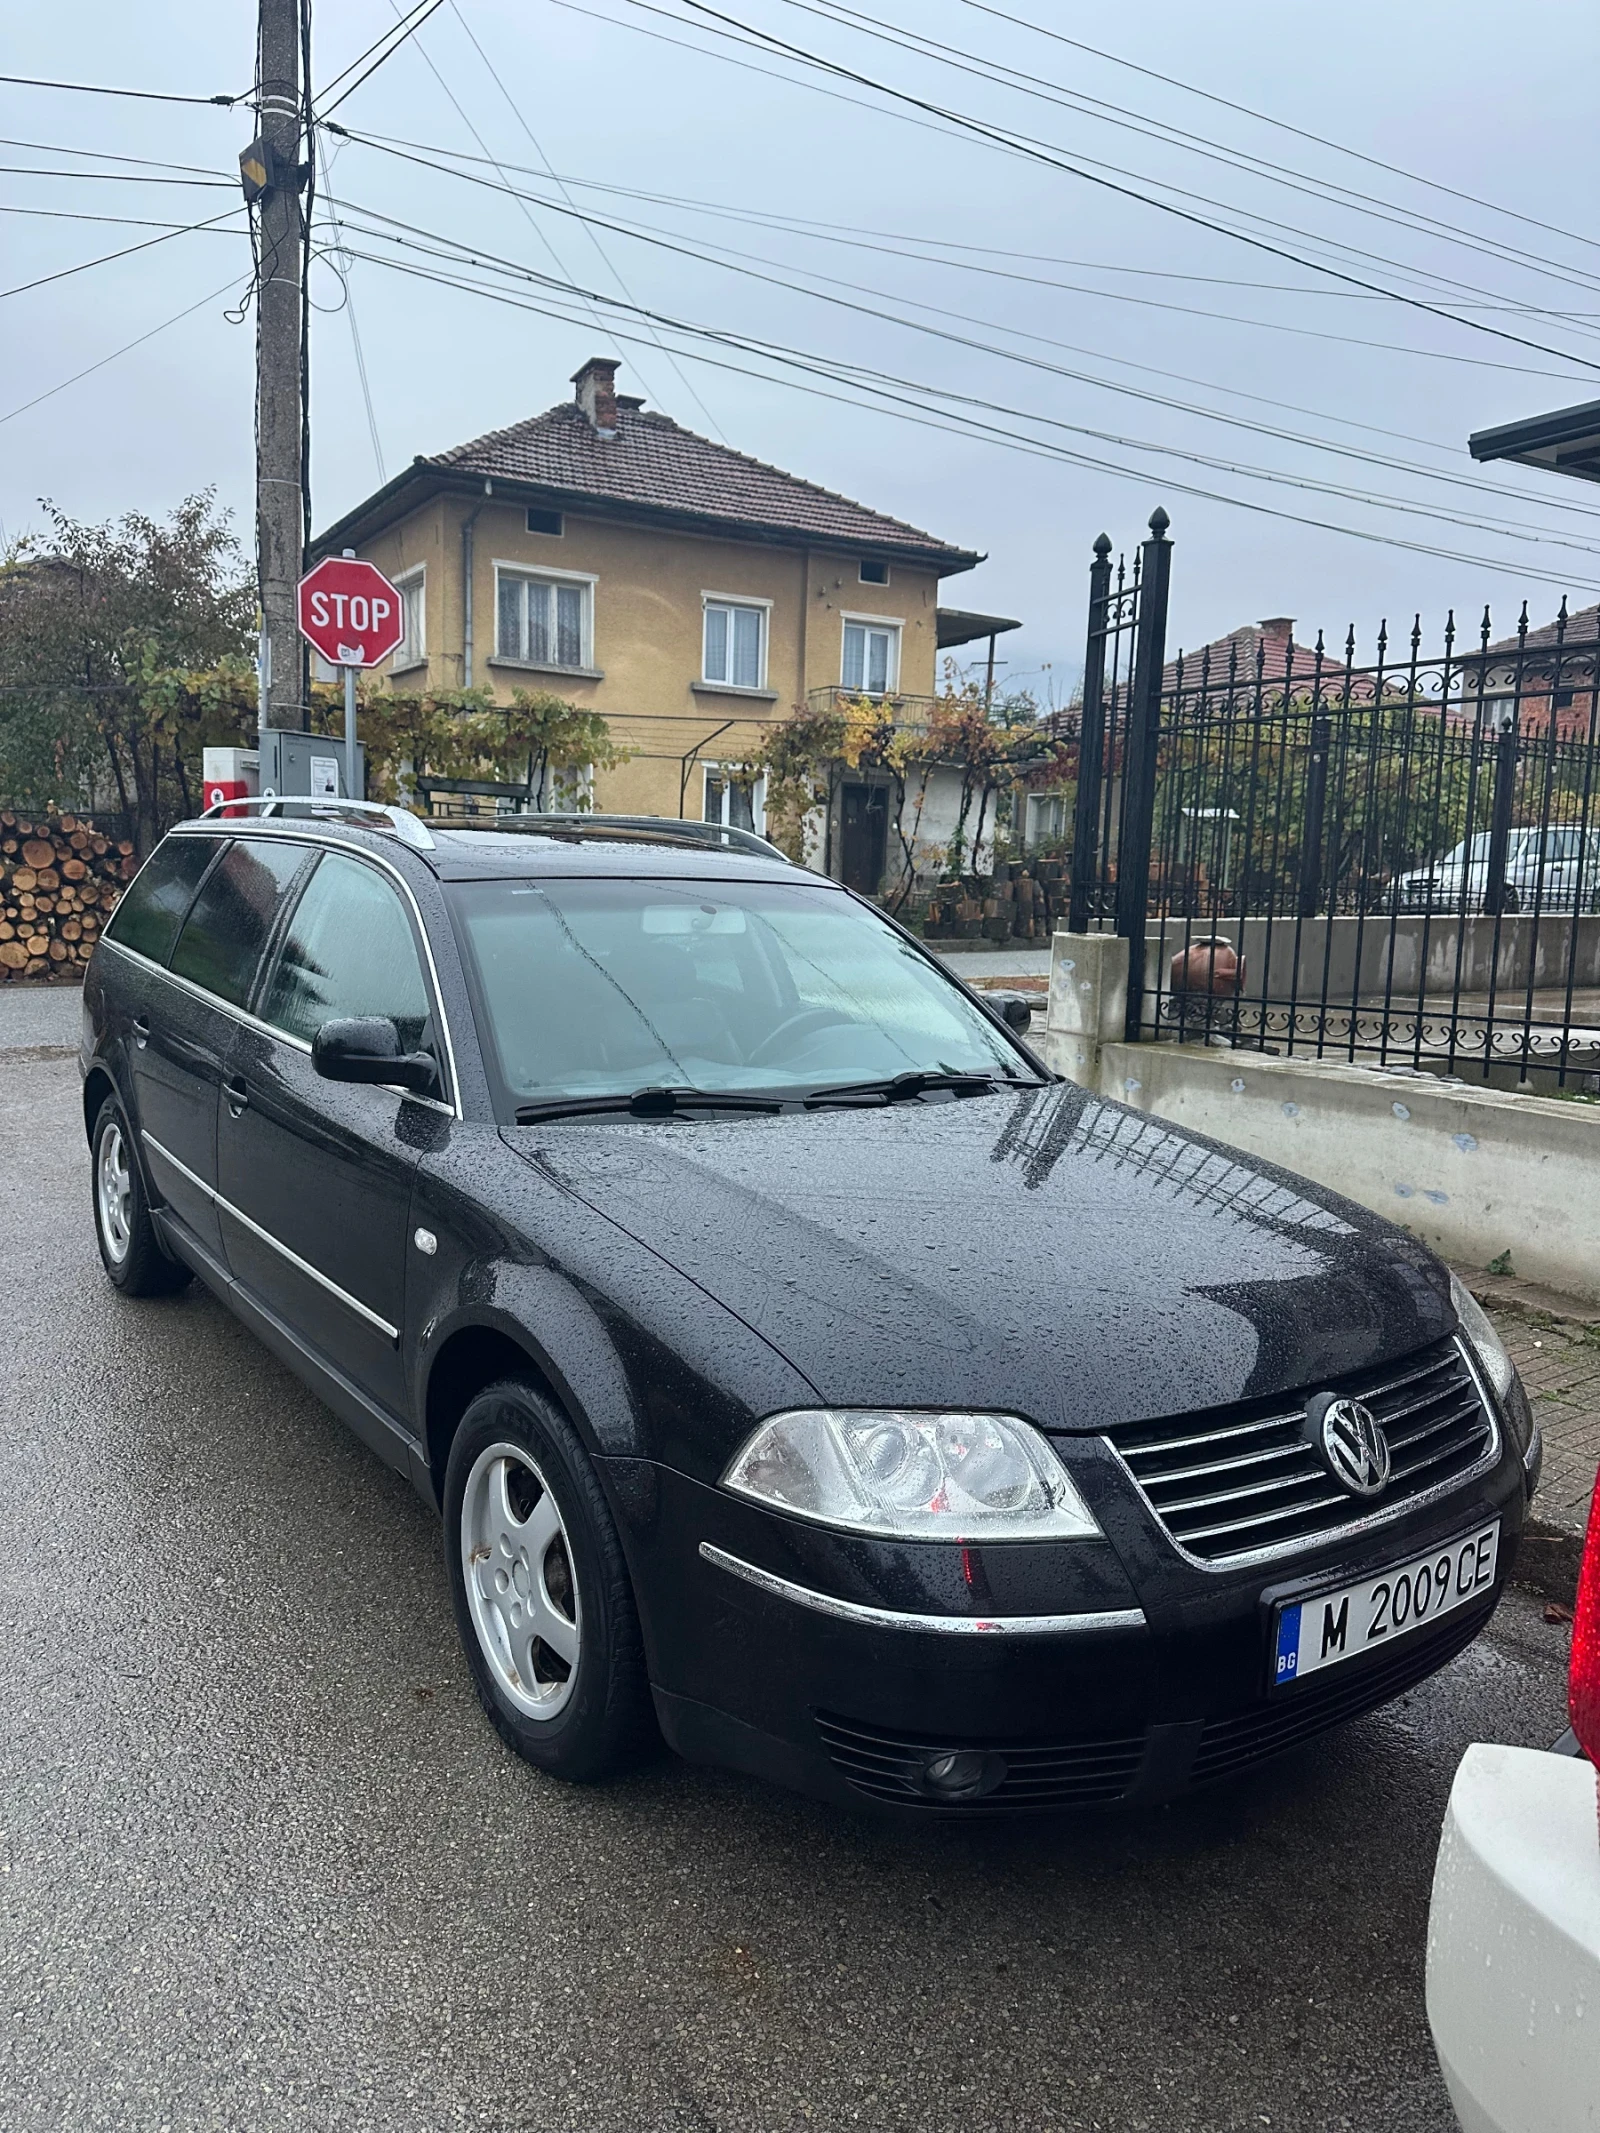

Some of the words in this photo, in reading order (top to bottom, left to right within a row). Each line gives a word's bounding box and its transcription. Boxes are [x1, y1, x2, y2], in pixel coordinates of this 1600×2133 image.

[311, 592, 390, 632] STOP
[1320, 1596, 1349, 1659] M
[1366, 1557, 1450, 1640] 2009
[1457, 1531, 1494, 1596] CE
[1277, 1652, 1296, 1674] BG
